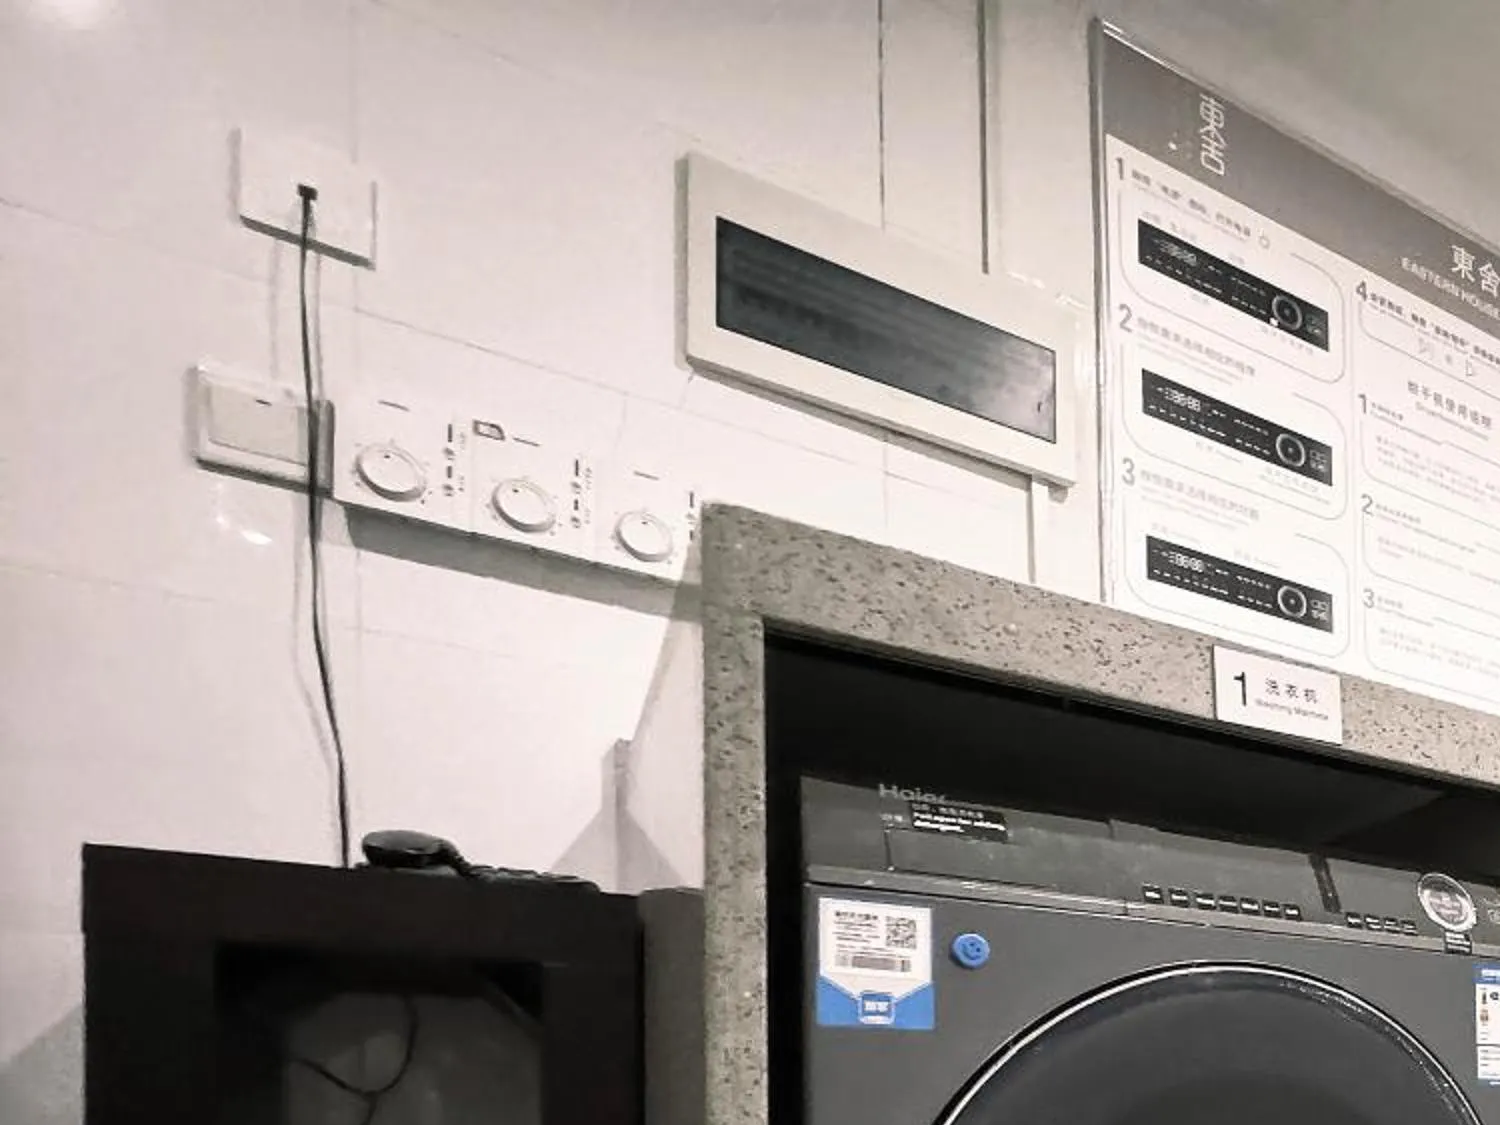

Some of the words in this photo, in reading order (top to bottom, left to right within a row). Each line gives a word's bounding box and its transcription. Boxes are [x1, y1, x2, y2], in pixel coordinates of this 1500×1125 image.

[1116, 157, 1124, 181] 1
[1356, 281, 1367, 302] 4
[1119, 304, 1133, 333] 2
[1358, 394, 1367, 414] 1
[1122, 458, 1135, 487] 3
[1361, 493, 1374, 516] 2
[1363, 588, 1375, 609] 3
[1234, 671, 1247, 707] 1
[879, 783, 946, 803] Haier
